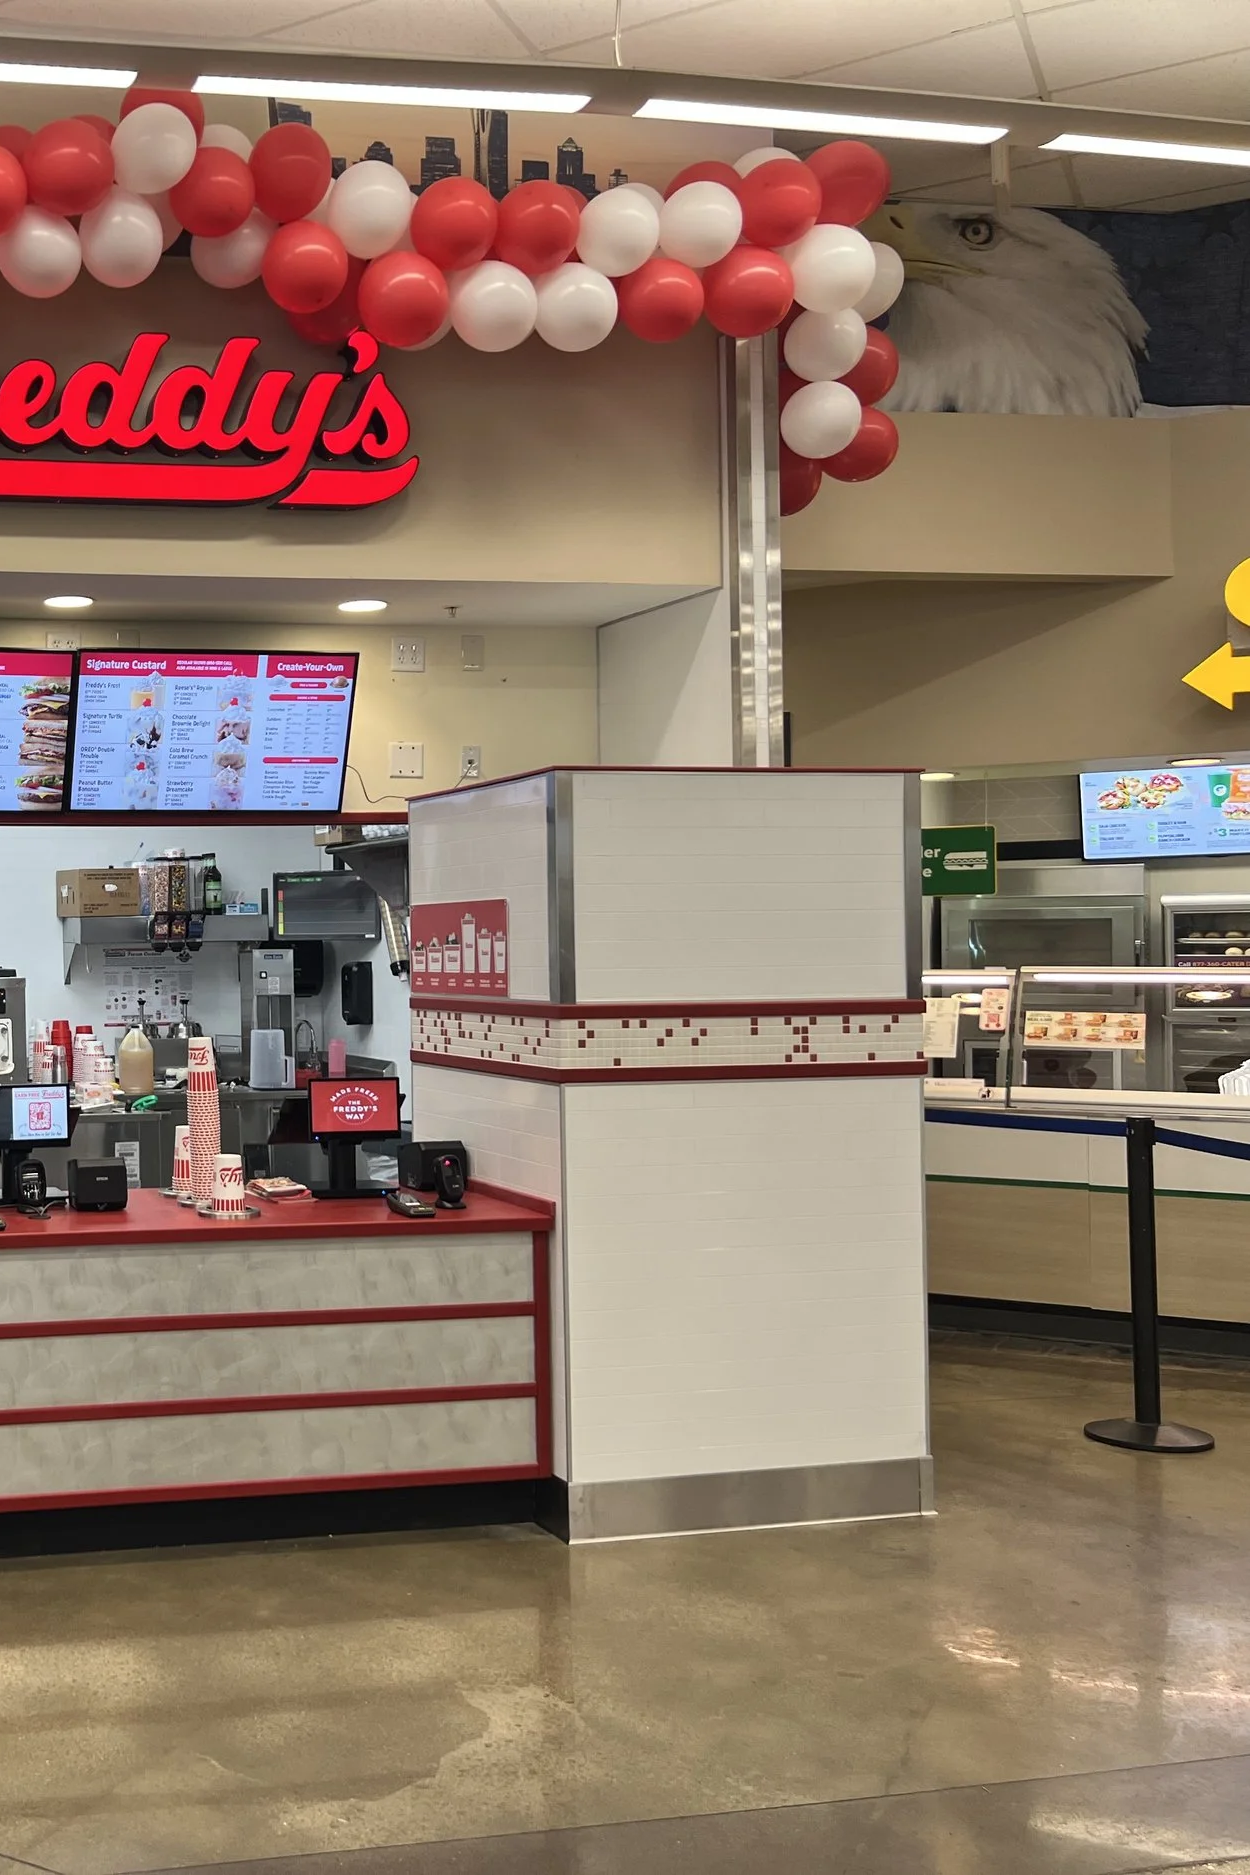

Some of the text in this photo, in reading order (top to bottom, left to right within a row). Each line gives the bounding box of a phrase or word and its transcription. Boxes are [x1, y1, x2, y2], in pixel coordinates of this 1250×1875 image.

[87, 659, 166, 671] Signature Custard
[277, 663, 344, 671] Create-Your-Own
[330, 1087, 379, 1102] MADE FRESH
